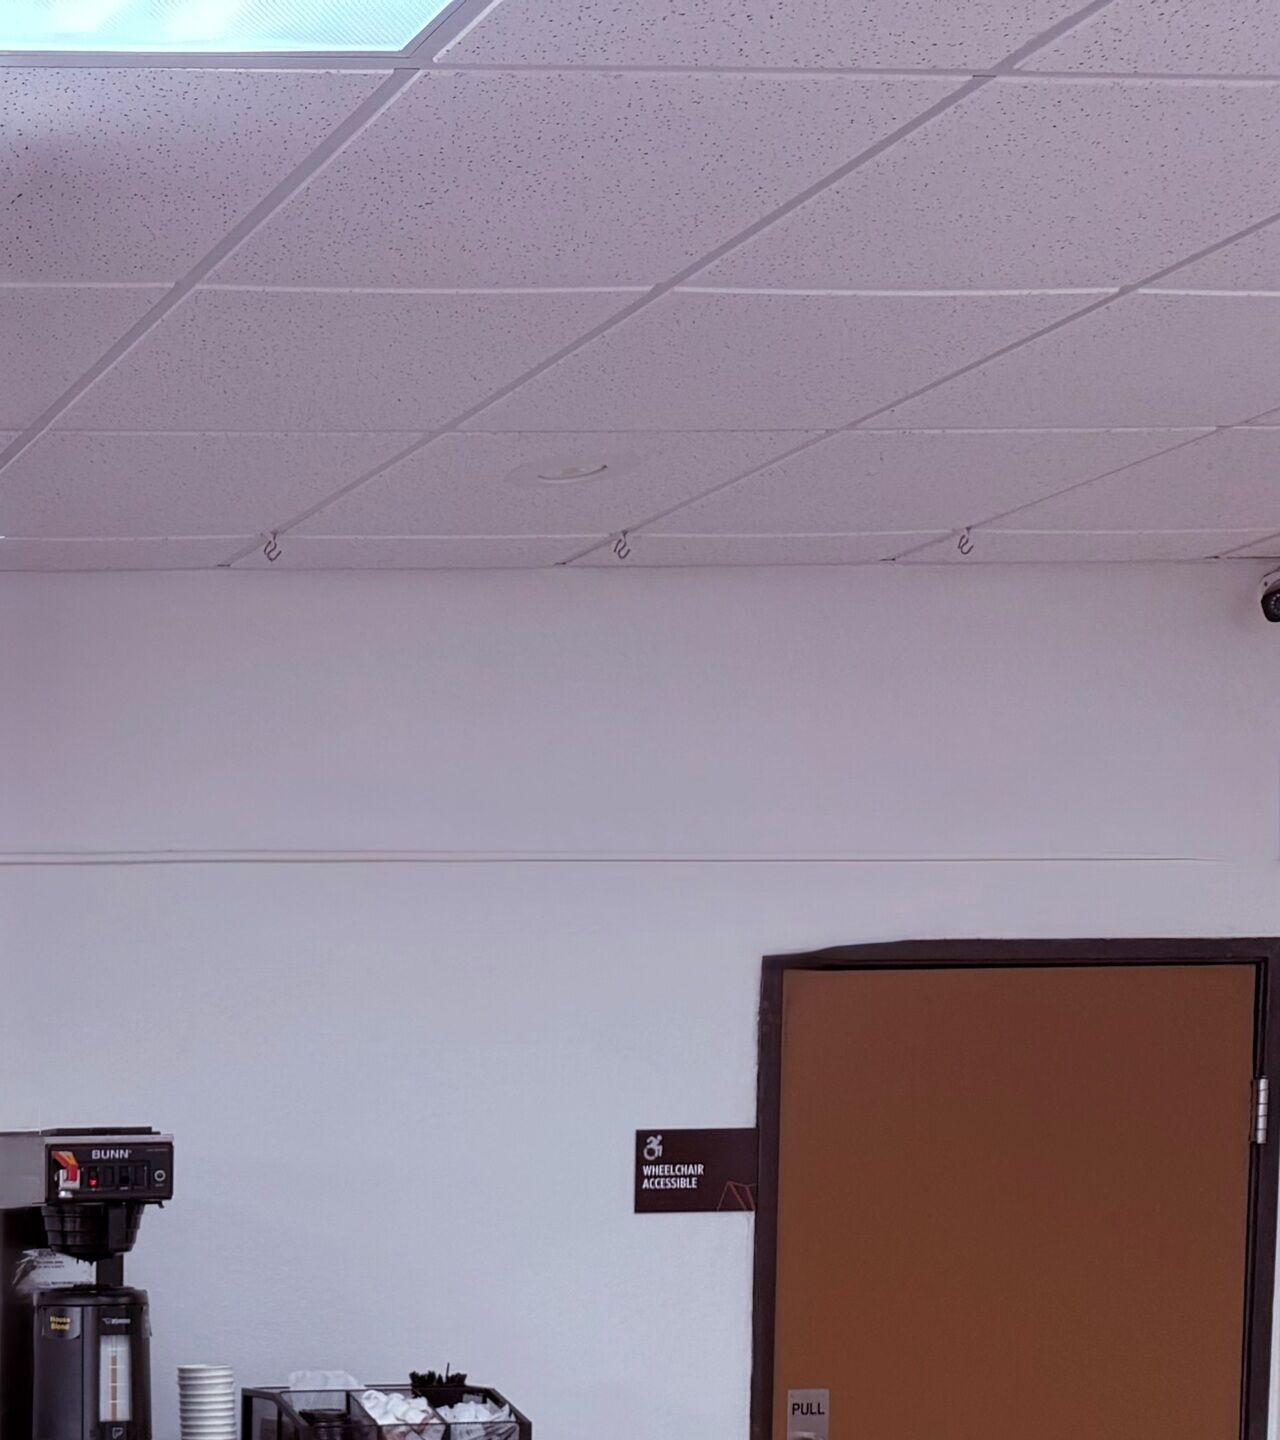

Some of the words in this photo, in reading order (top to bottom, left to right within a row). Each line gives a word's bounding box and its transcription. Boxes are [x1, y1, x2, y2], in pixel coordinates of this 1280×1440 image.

[91, 1149, 130, 1159] BUNN
[643, 1164, 704, 1176] WHEELCHAIR
[642, 1177, 698, 1189] ACCESSIBLE
[792, 1402, 825, 1416] PULL
